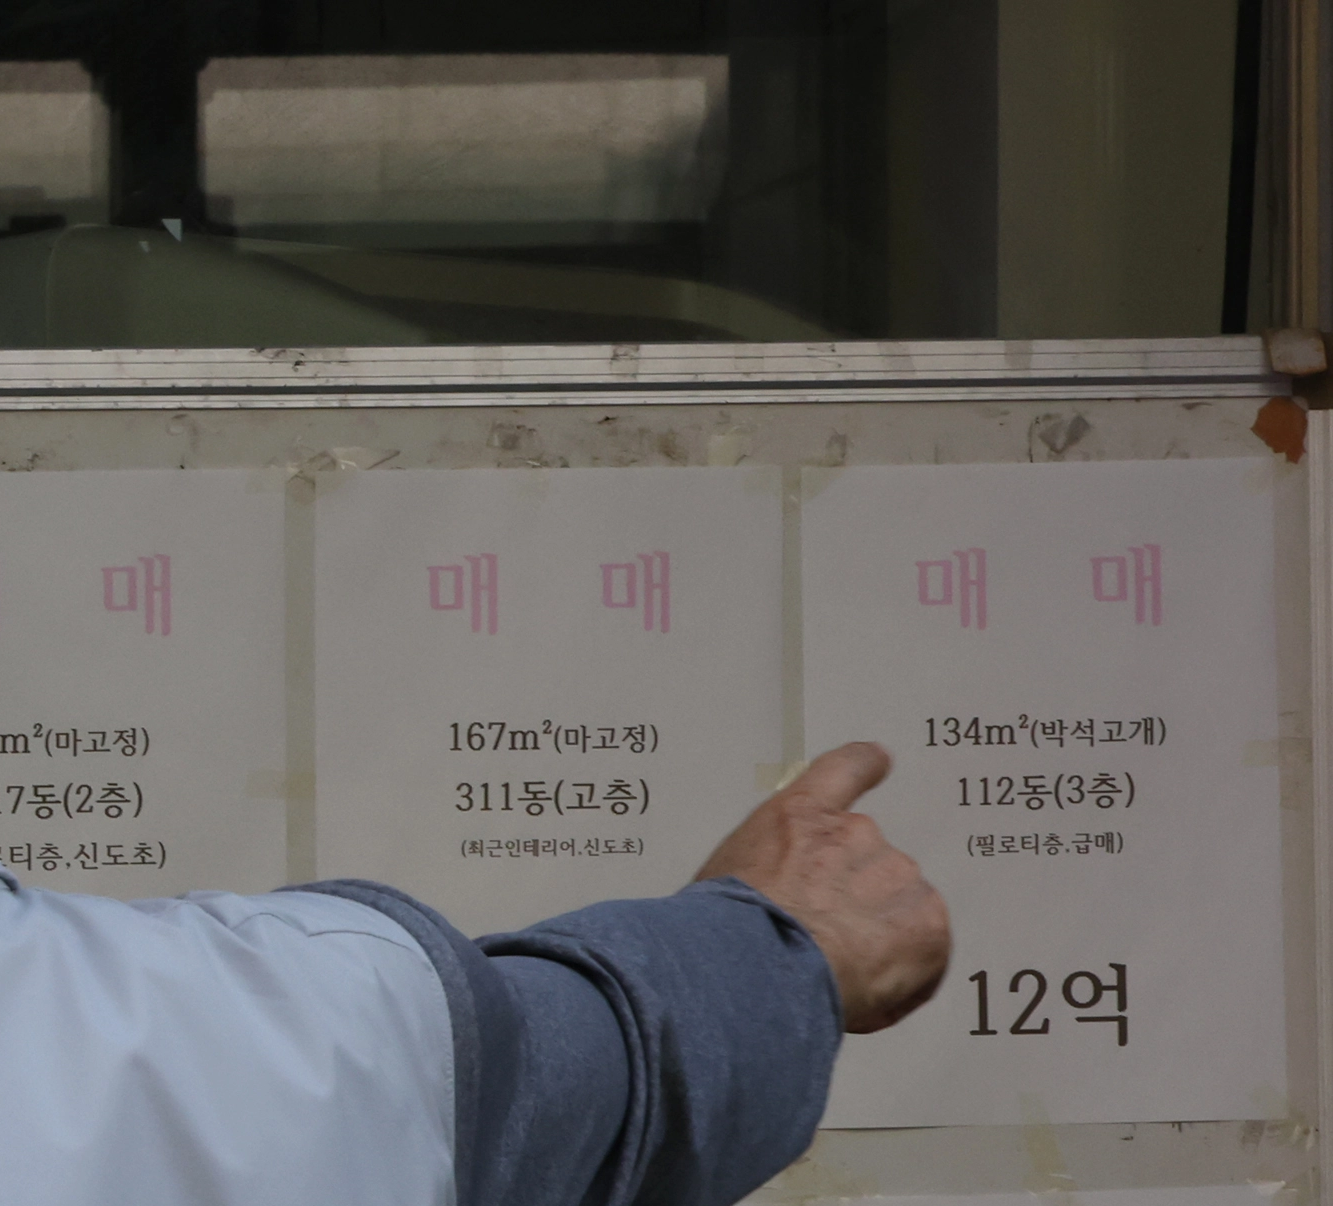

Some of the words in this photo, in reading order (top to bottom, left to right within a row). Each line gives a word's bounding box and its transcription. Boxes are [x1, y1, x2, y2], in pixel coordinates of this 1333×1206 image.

[101, 553, 173, 637] 매
[427, 552, 500, 636] 매
[600, 550, 672, 634] 매
[915, 547, 989, 631] 매
[1089, 543, 1164, 627] 매
[455, 778, 650, 817] 311동(고층)
[958, 771, 1136, 811] 112동(3층)
[968, 962, 1129, 1048] 12억
